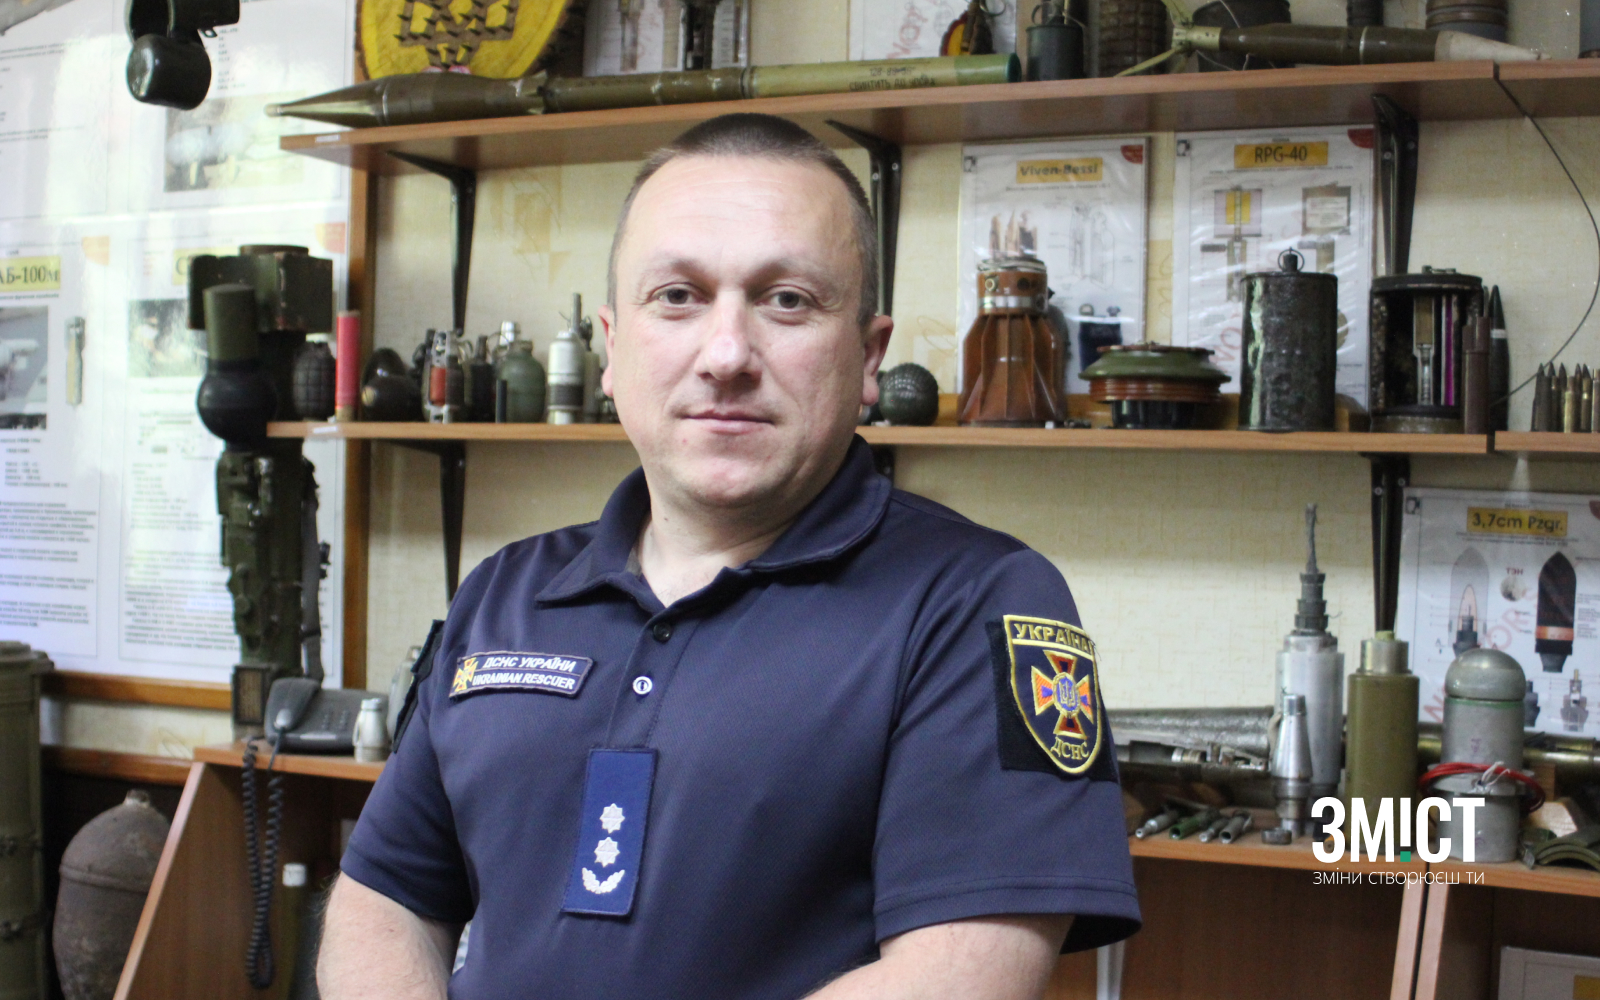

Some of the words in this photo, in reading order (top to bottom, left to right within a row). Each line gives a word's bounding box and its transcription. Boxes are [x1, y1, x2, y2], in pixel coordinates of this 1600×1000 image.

[1254, 145, 1308, 163] RPG-40
[1472, 512, 1523, 529] 3,7cm
[1528, 515, 1563, 533] Pzgr.
[1014, 623, 1090, 653] УКРАЇНА
[482, 656, 518, 669] ДСНС
[519, 656, 577, 673] УКРАЇНИ
[472, 672, 521, 686] UKRAINIAN
[521, 672, 576, 690] RESCUER
[1050, 736, 1090, 761] ДСНС
